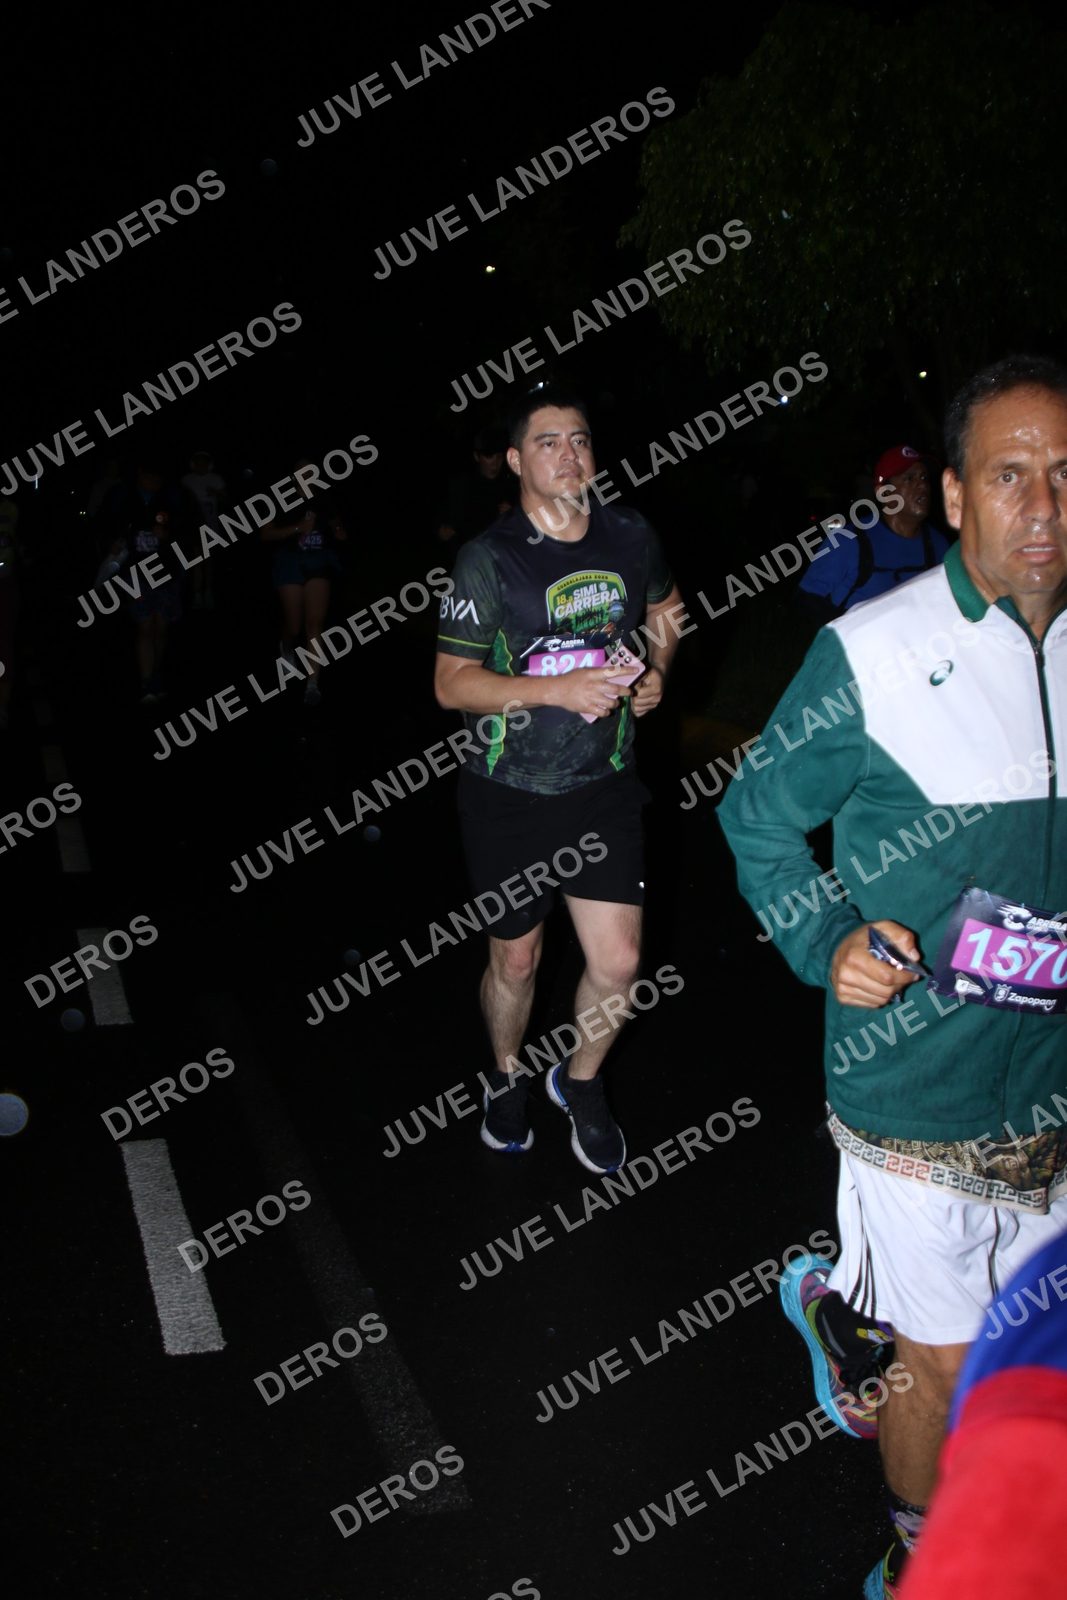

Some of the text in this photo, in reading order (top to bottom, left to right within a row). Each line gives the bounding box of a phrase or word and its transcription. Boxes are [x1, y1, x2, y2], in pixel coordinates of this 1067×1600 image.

[554, 588, 620, 618] CARRERA
[573, 583, 598, 598] SIMI
[440, 596, 480, 626] BVA
